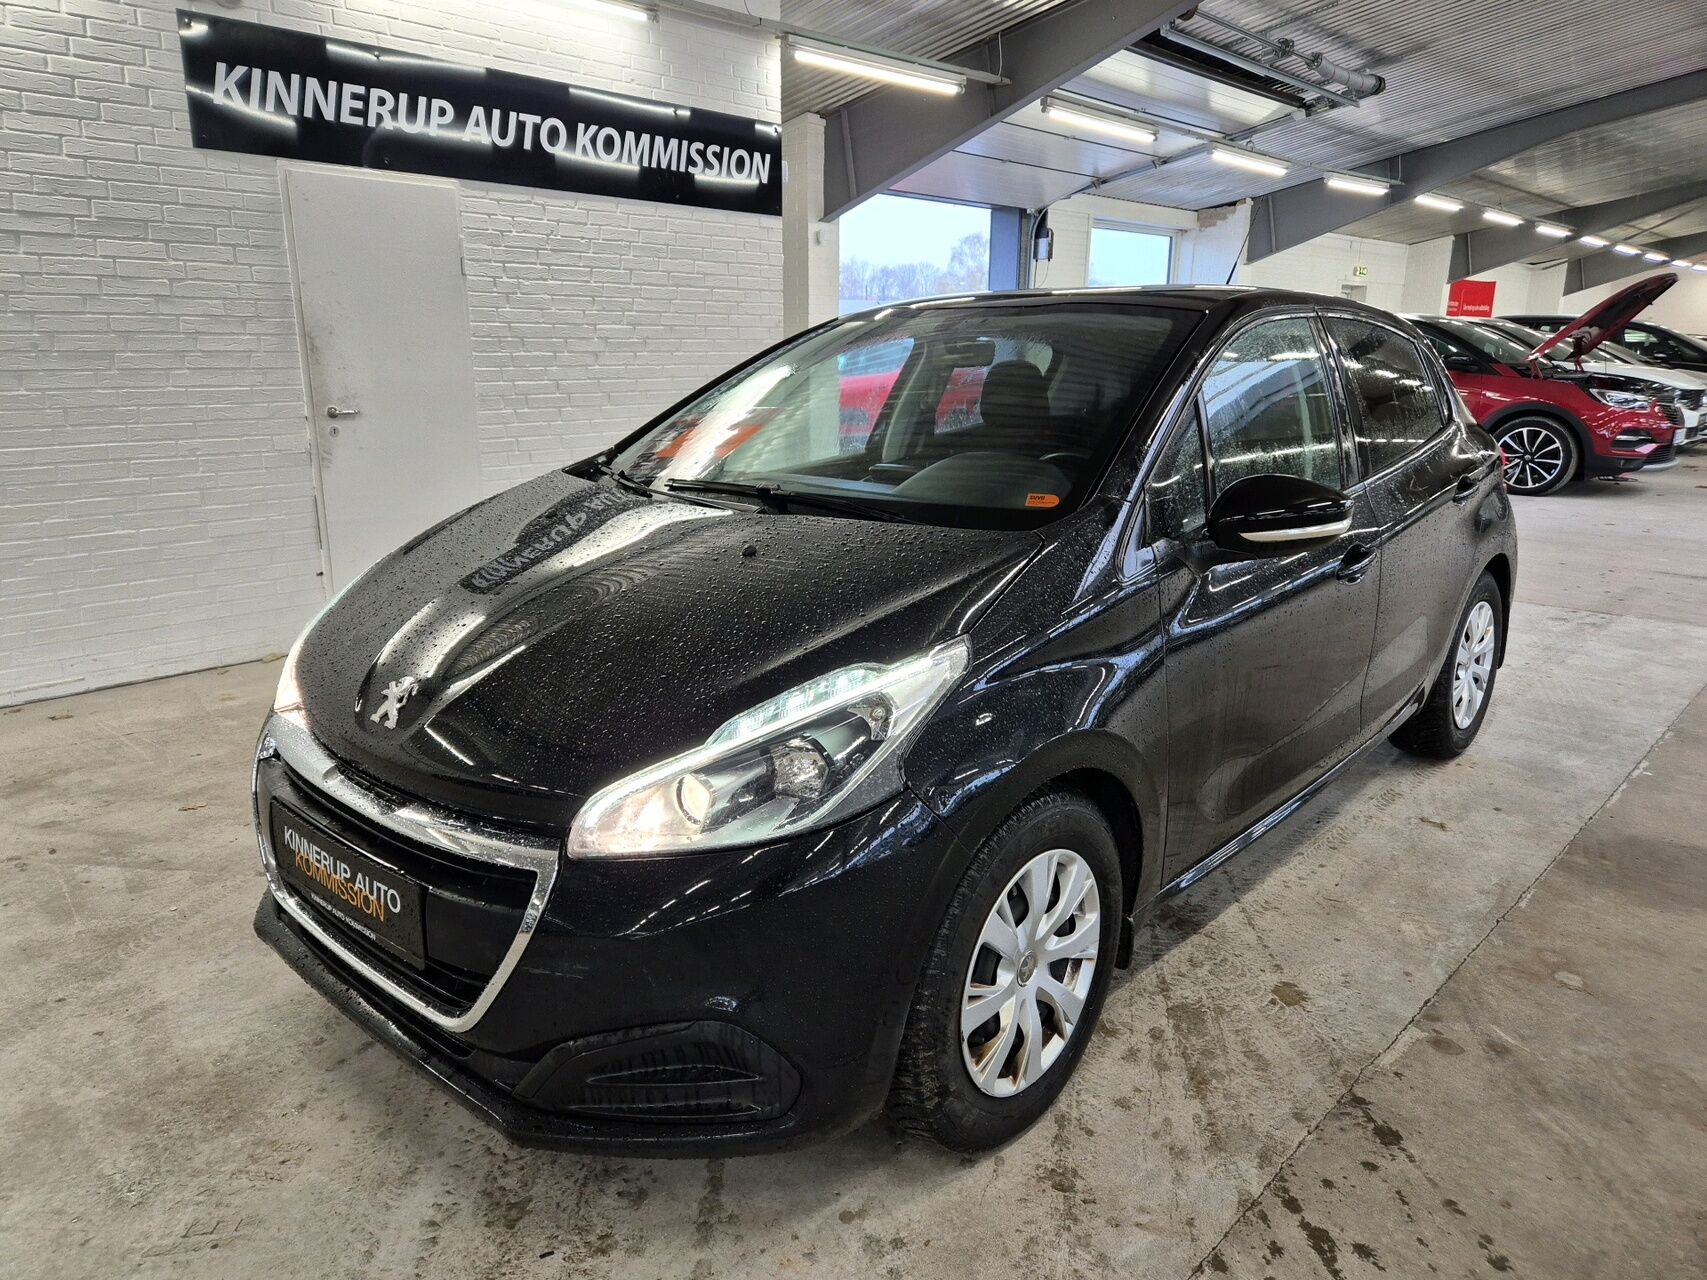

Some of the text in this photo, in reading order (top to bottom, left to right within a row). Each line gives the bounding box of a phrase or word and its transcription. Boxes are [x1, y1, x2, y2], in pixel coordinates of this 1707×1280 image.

[212, 61, 771, 184] KINNERUP AUTO KOMMISSION
[284, 826, 401, 914] KINNERUP AUTO
[295, 852, 385, 923] KOMMISSION
